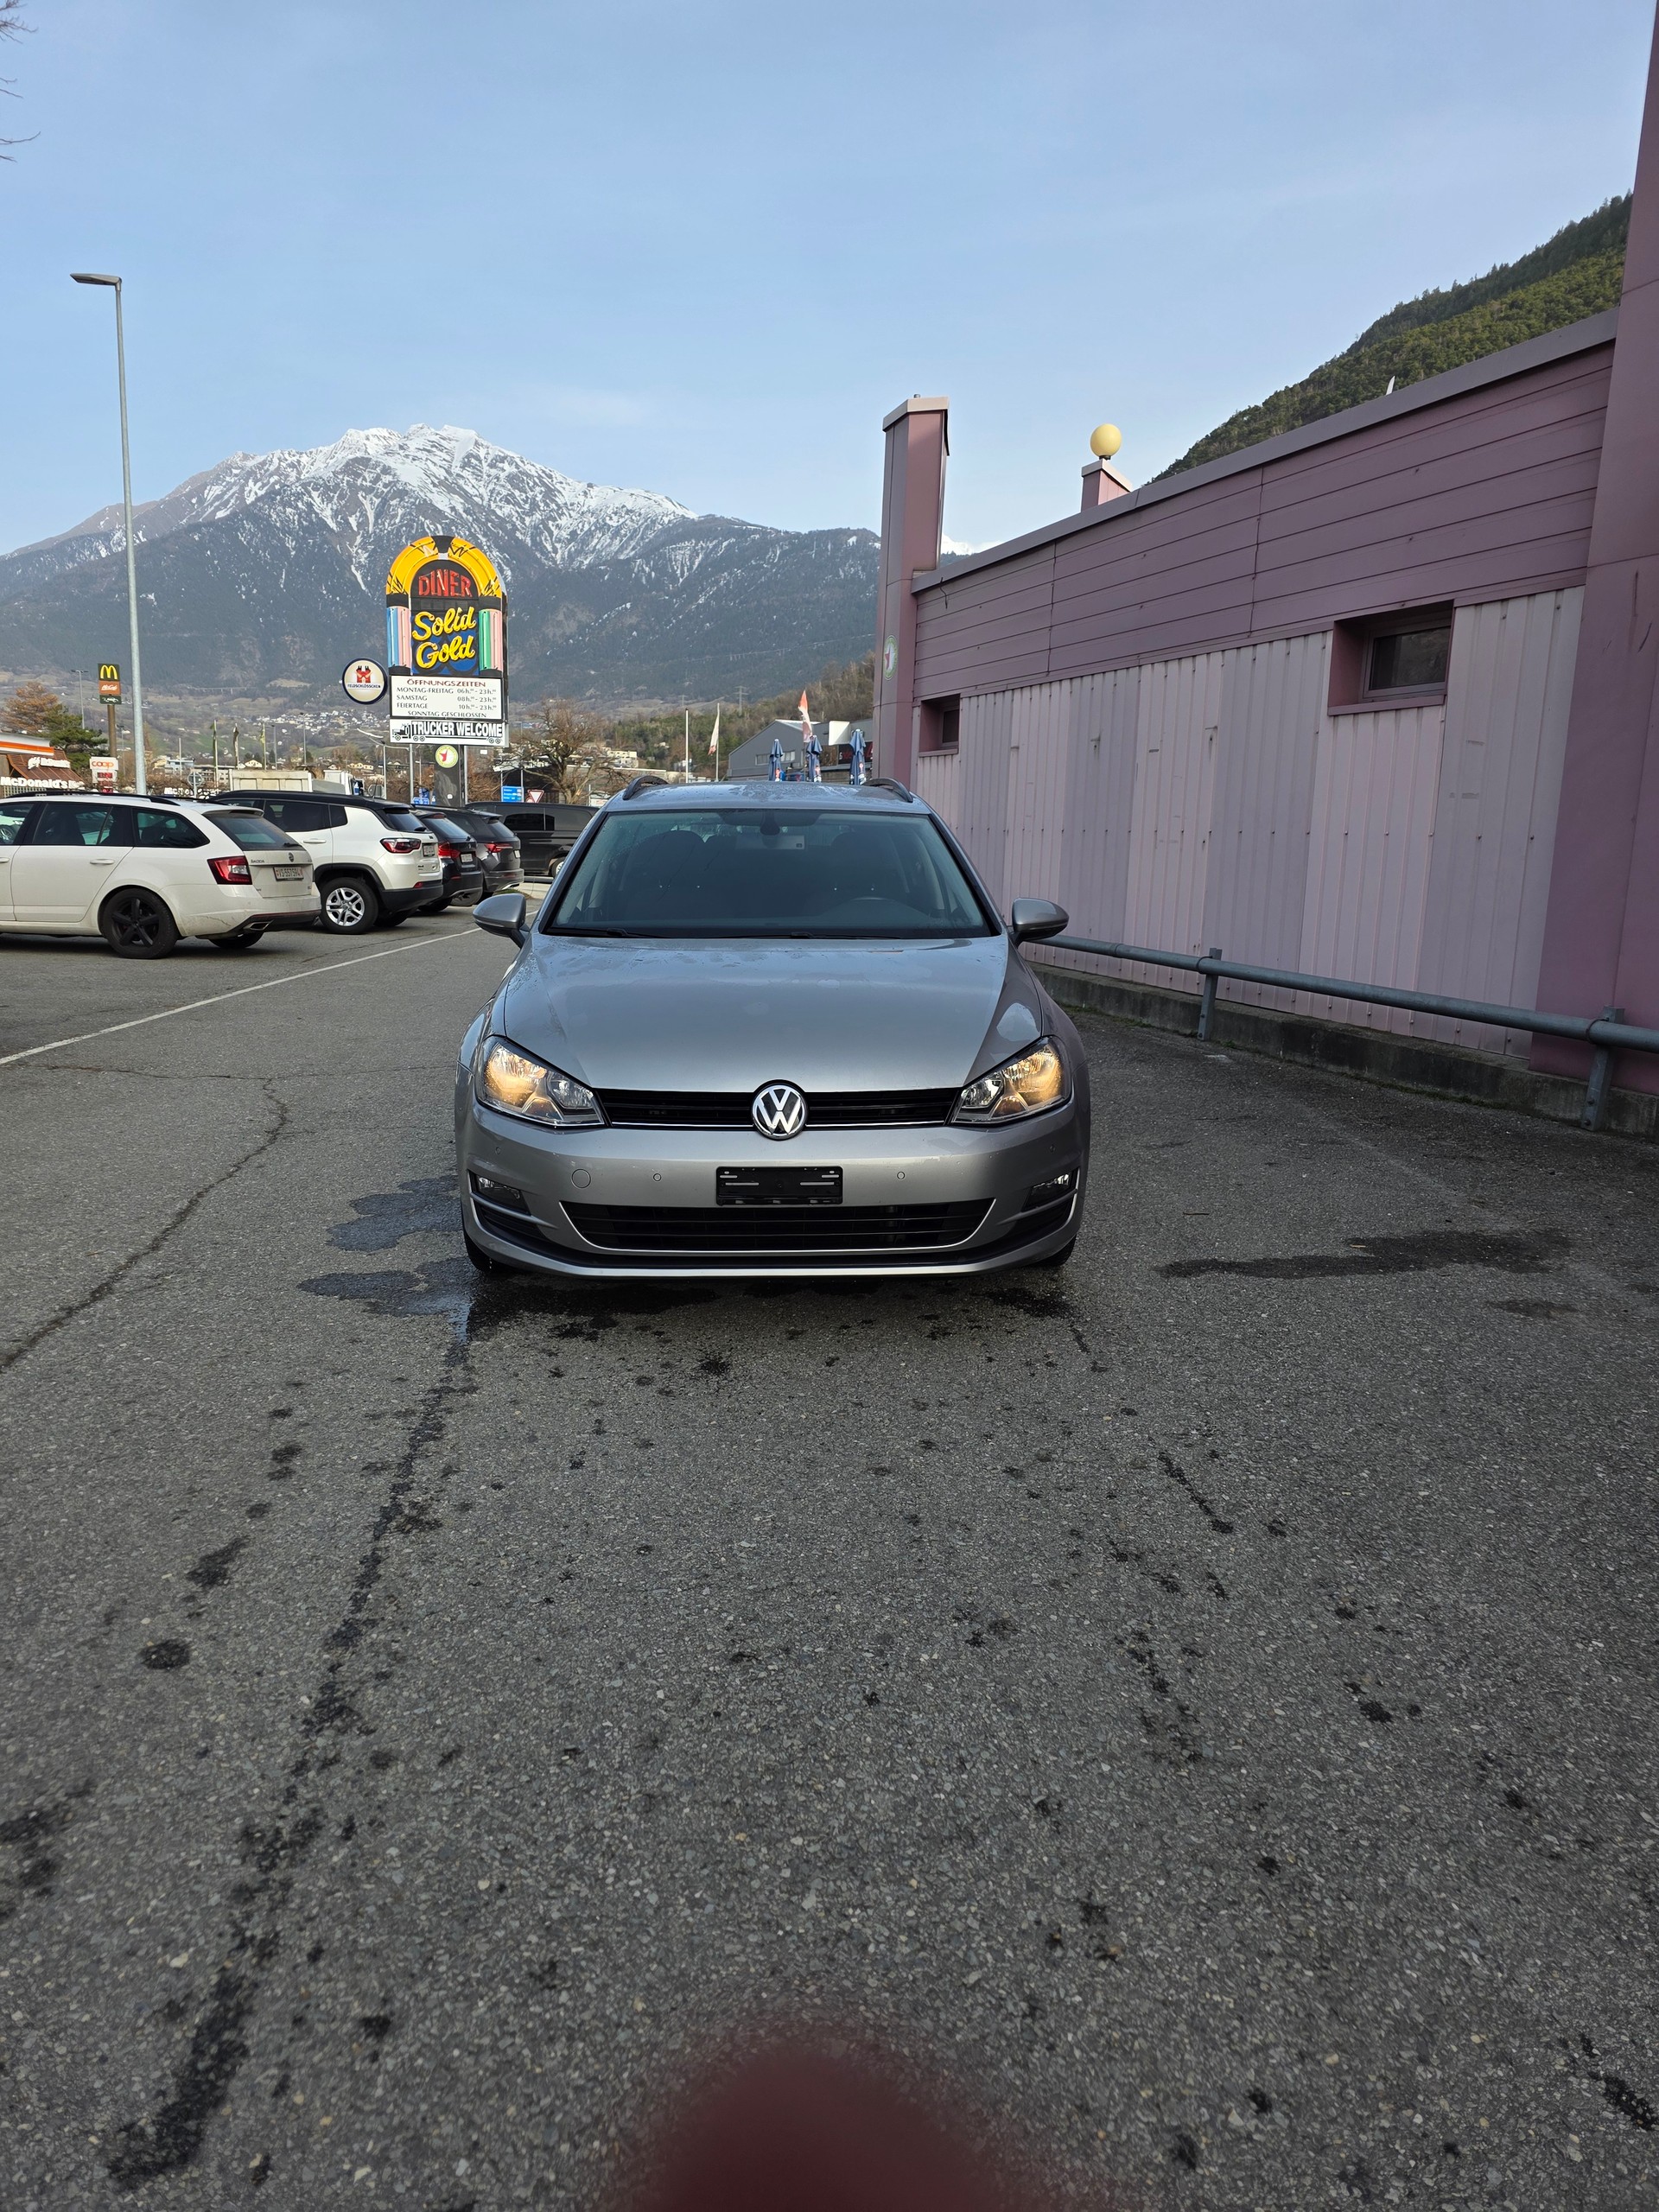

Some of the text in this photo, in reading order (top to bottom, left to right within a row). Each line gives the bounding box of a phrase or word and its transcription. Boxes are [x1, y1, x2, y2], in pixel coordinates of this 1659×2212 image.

[417, 569, 473, 598] DINER
[411, 607, 476, 641] Solid
[416, 635, 476, 669] Gold
[407, 678, 486, 687] ÖFFNUNGSZEITEN
[411, 721, 502, 737] TRUCKER WELCOME
